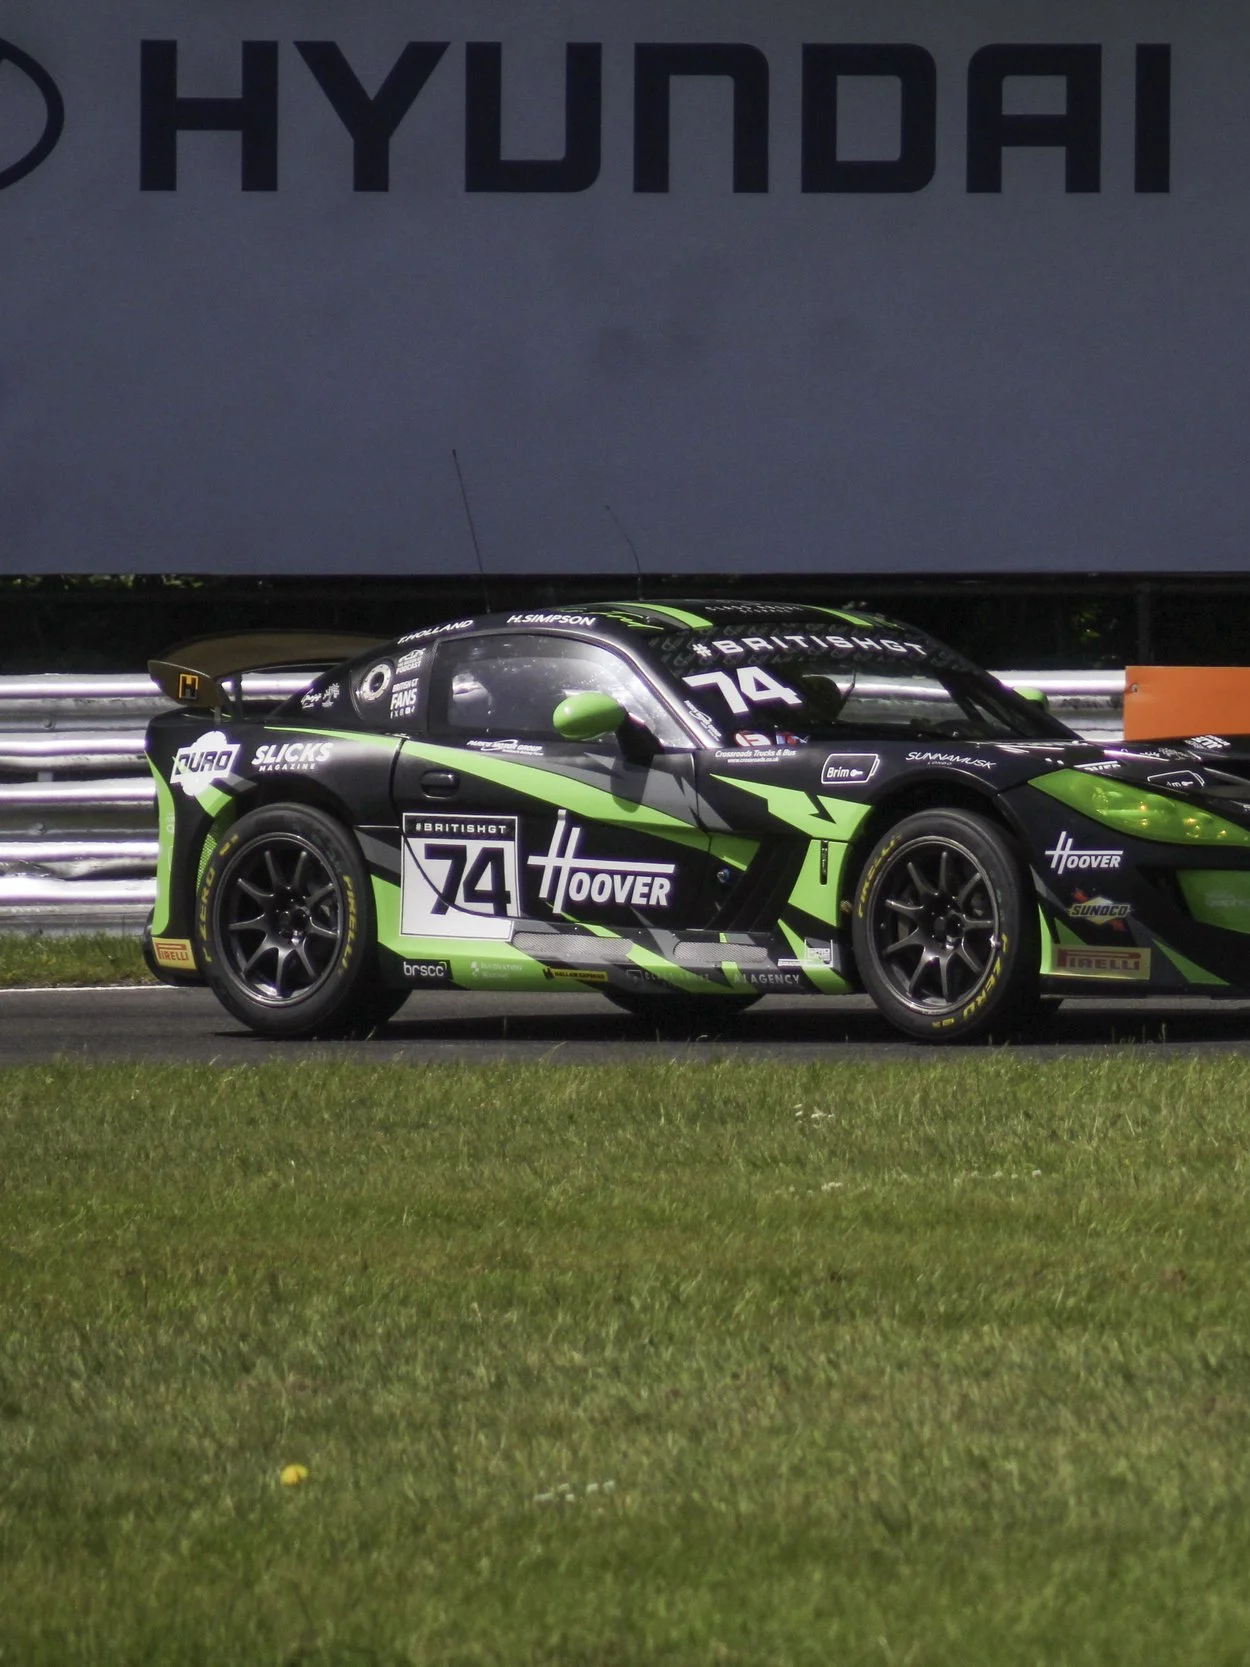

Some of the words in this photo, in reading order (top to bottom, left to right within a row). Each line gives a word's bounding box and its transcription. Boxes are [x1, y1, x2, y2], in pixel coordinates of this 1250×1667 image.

[140, 40, 1171, 193] HYUNDAI
[506, 614, 596, 626] H.SIMPSON
[397, 620, 474, 644] T.HOLLAND
[692, 635, 928, 657] #BRITISHGT
[682, 666, 802, 714] 74
[390, 688, 417, 711] FANS
[252, 743, 334, 766] SLICKS
[905, 751, 997, 769] SUNNAMUSK
[258, 762, 317, 773] MAGAZINE
[826, 766, 850, 779] Brim
[415, 822, 507, 835] #BRITISHGT
[424, 843, 511, 916] 74
[1071, 904, 1130, 917] SUNOCO
[156, 943, 189, 961] PIRELLI
[1057, 950, 1141, 971] PIRELLI
[403, 961, 447, 978] brscc
[750, 974, 800, 985] AGENCY
